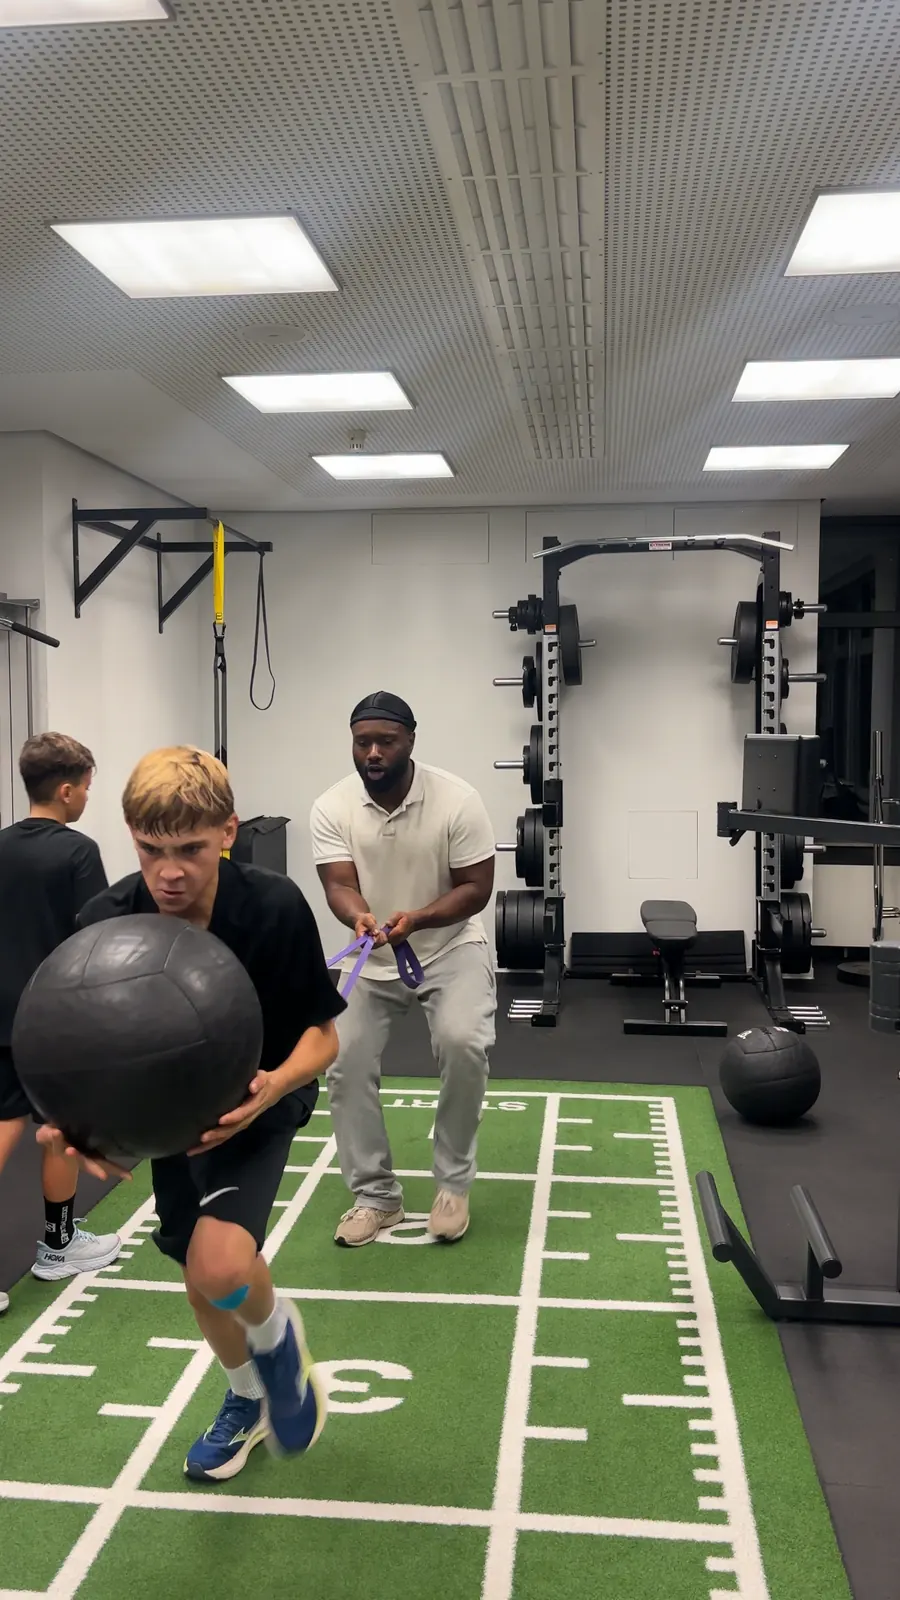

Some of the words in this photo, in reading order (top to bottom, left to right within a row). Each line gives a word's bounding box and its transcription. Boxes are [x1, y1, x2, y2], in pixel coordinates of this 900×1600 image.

[383, 1098, 529, 1112] STRT
[44, 1253, 65, 1262] HOKA
[311, 1358, 414, 1414] 3
